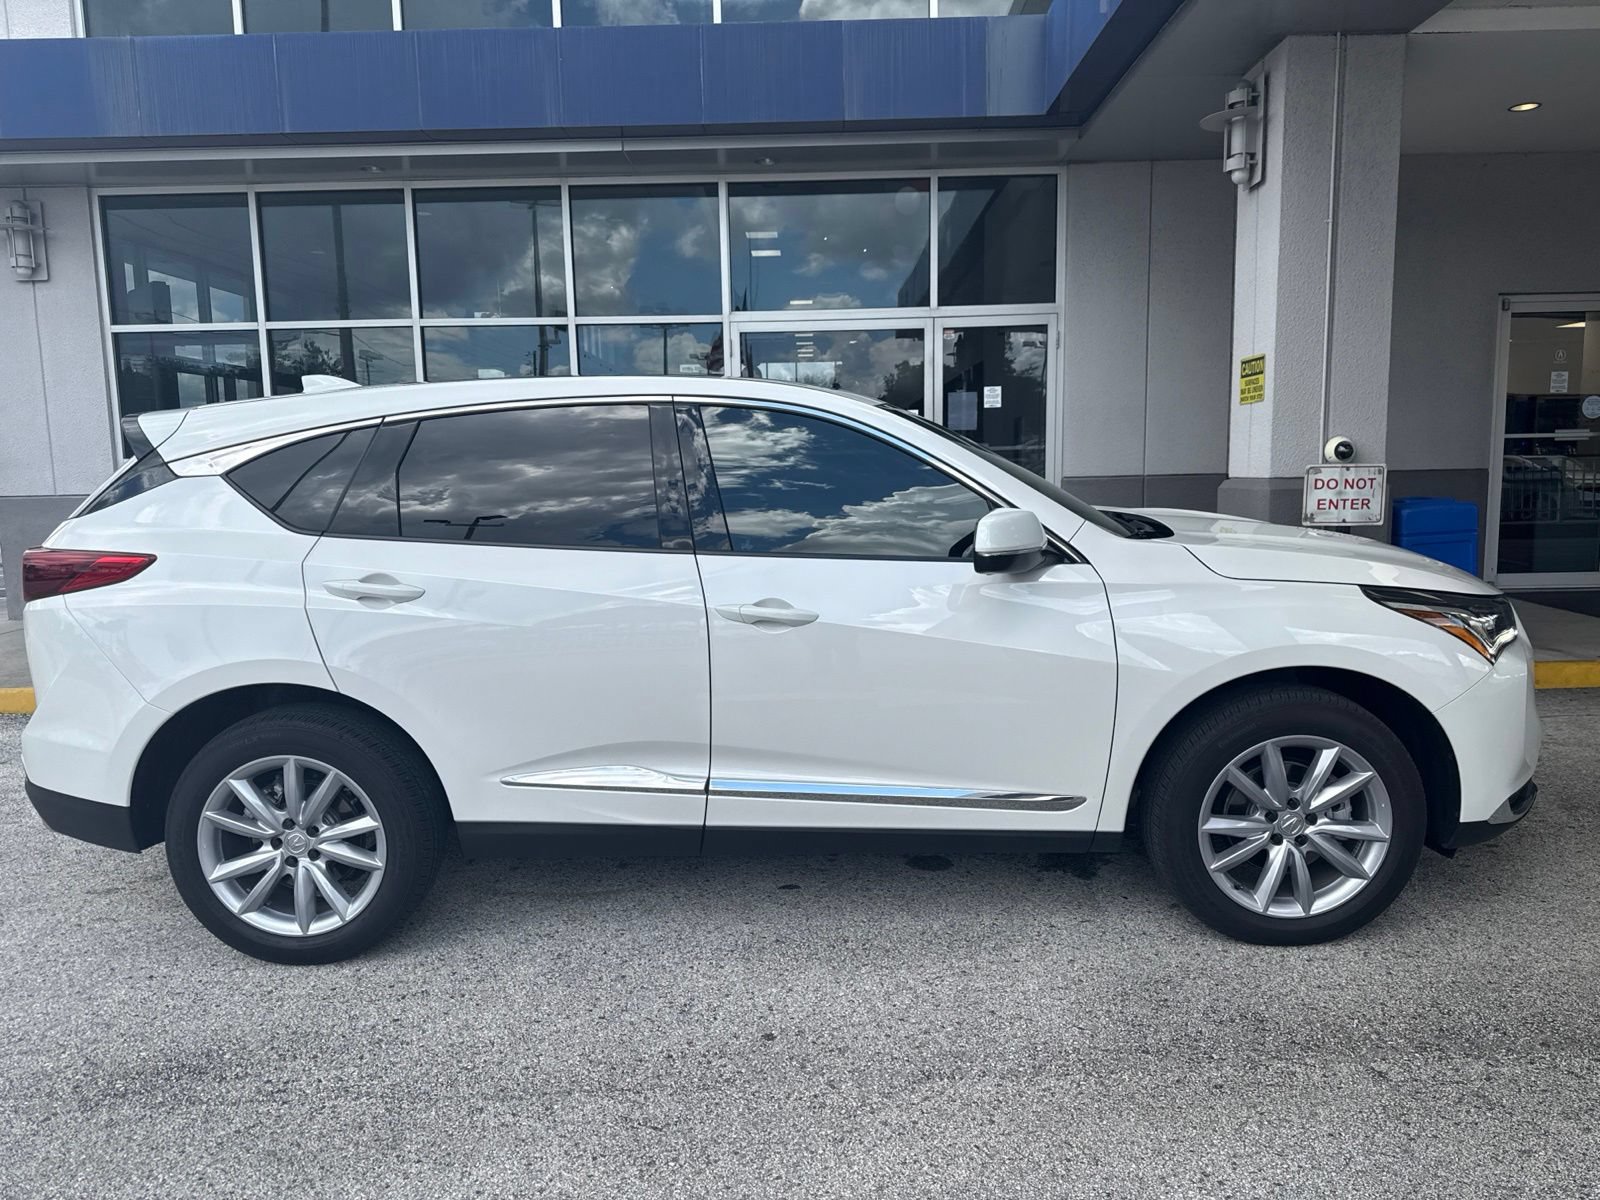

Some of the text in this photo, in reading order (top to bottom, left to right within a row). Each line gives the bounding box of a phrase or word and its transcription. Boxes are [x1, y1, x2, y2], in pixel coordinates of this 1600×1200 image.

[1242, 359, 1264, 376] CAUTION
[1314, 477, 1377, 490] DO NOT
[1317, 498, 1371, 510] ENTER
